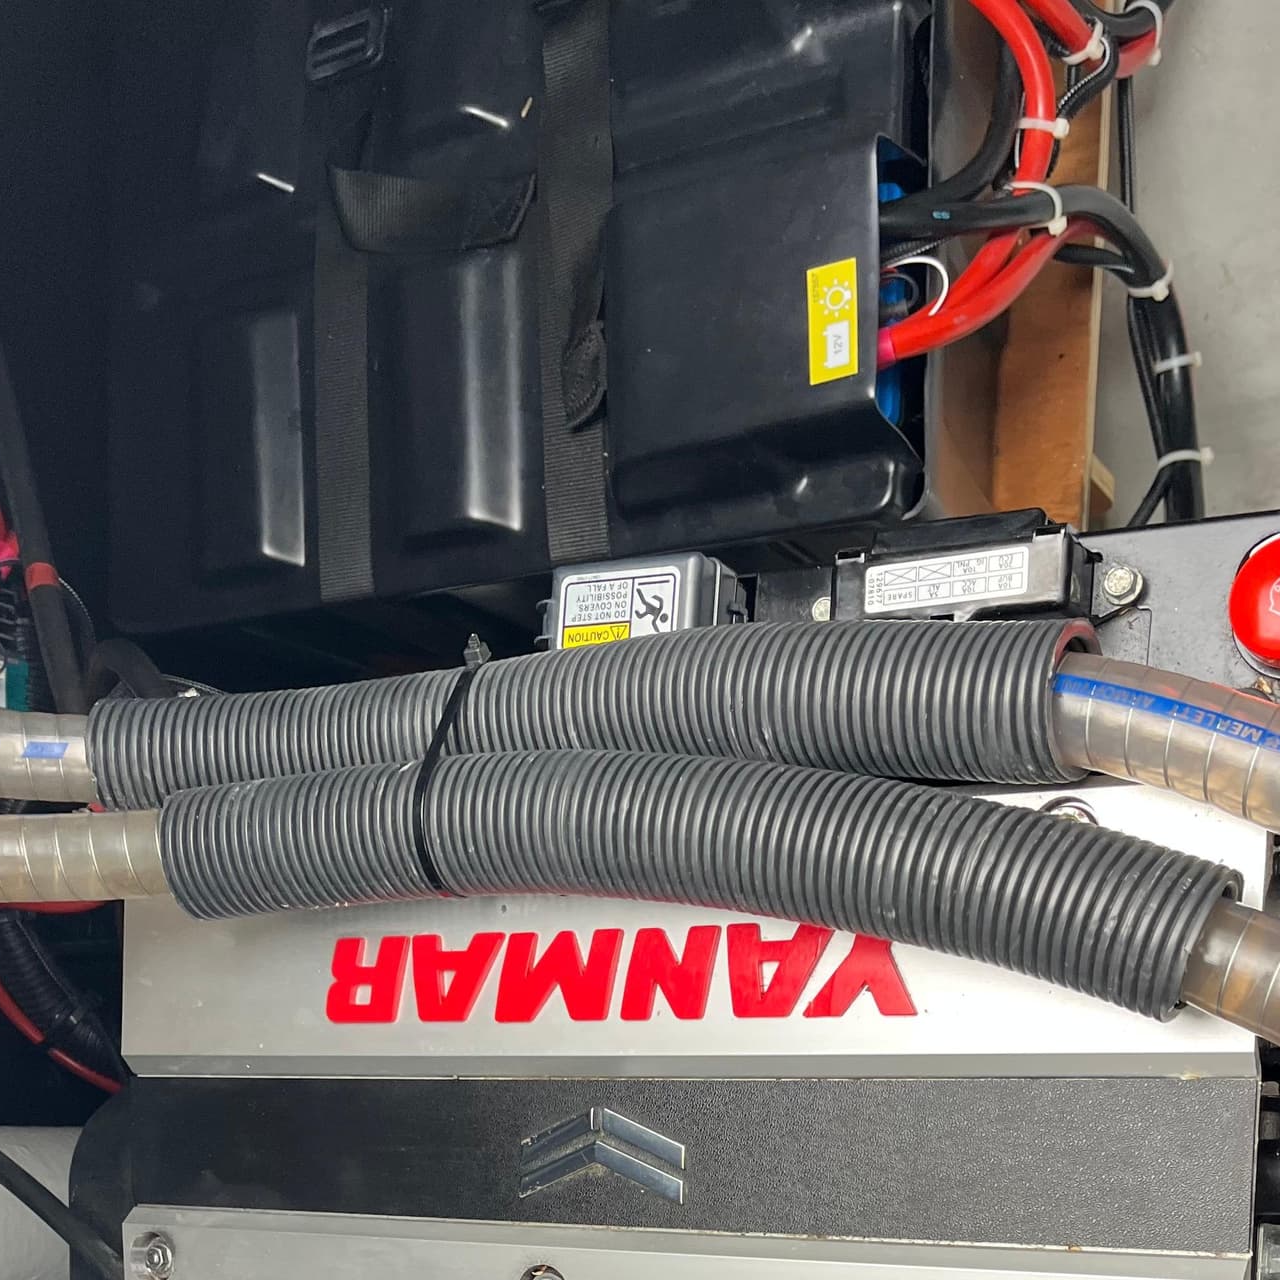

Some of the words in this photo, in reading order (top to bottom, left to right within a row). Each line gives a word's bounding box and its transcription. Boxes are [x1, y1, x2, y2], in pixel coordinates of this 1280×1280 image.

[833, 335, 842, 355] 12V
[617, 581, 628, 590] OF
[576, 591, 628, 603] POSSIBILITY
[888, 591, 913, 601] SPARE
[615, 600, 627, 609] ON
[571, 613, 592, 622] STEP
[594, 611, 611, 620] NOT
[614, 610, 626, 618] DO
[568, 630, 610, 643] CAUTION
[1169, 704, 1263, 742] MERLETT
[326, 923, 920, 1024] YANMAR
